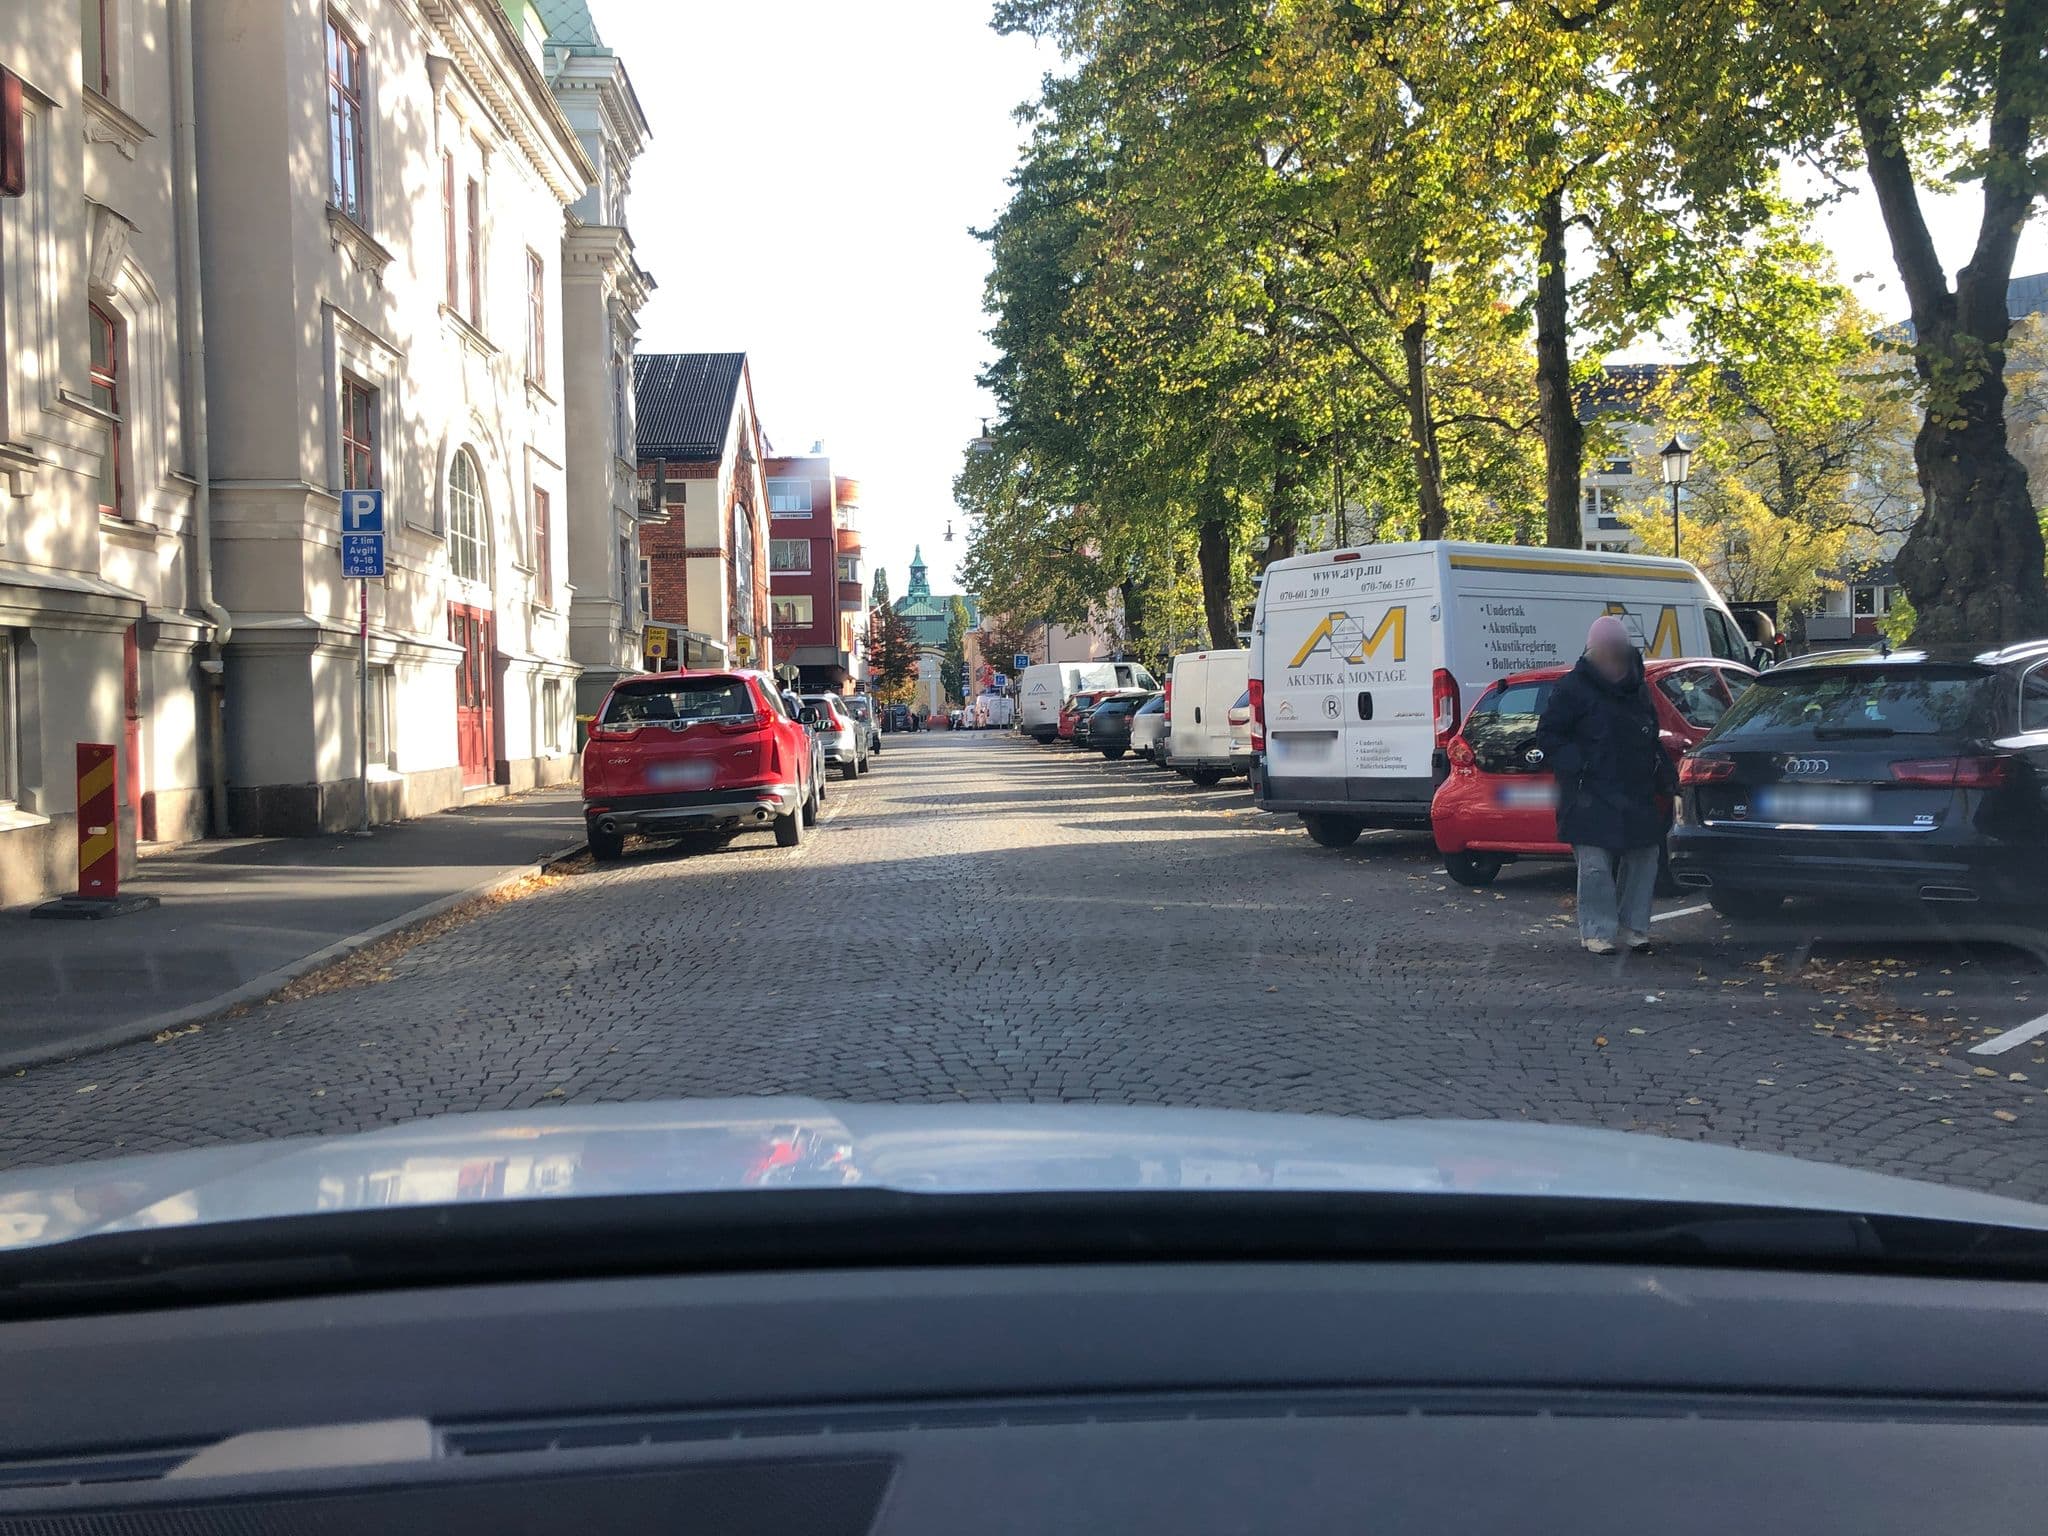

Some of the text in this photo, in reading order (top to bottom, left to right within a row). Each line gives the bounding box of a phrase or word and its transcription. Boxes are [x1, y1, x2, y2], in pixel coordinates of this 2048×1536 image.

[353, 495, 375, 528] P
[350, 547, 376, 556] Avgift
[1313, 564, 1382, 581] www.avp.nu
[1361, 577, 1416, 592] 070-766 15 07
[1280, 587, 1330, 600] 070-601 20 19
[1486, 603, 1525, 616] Undertak
[1488, 622, 1536, 637] Akustikputs
[1490, 640, 1557, 653] Akustikreglering
[1286, 670, 1407, 686] AKUSTIK & MONTAGE
[1329, 701, 1337, 715] R
